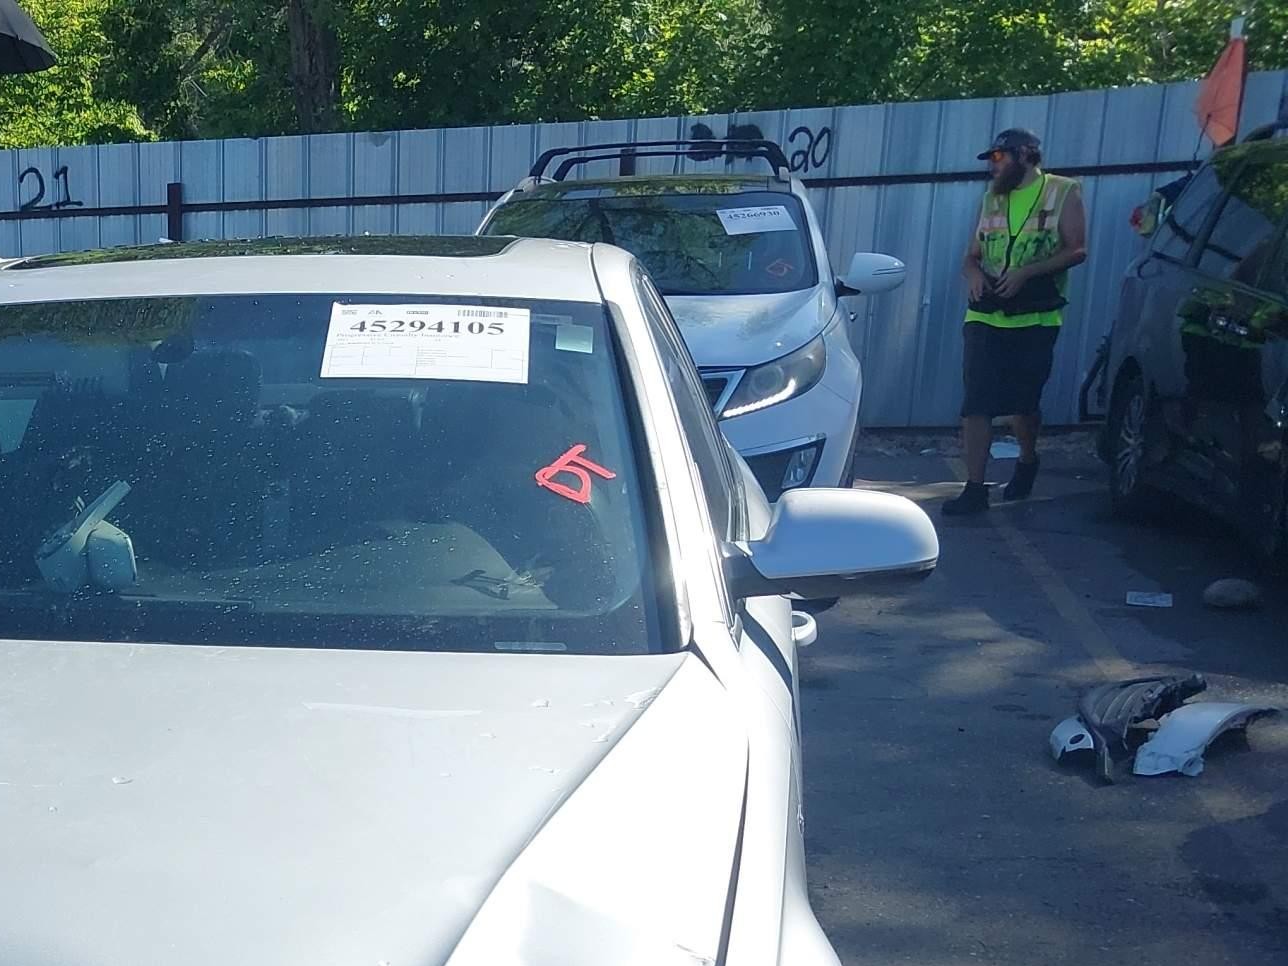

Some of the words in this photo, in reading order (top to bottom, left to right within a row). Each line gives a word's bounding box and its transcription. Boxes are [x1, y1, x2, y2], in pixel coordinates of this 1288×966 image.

[789, 126, 831, 173] 20
[18, 166, 83, 210] 21
[350, 319, 506, 336] 45294105
